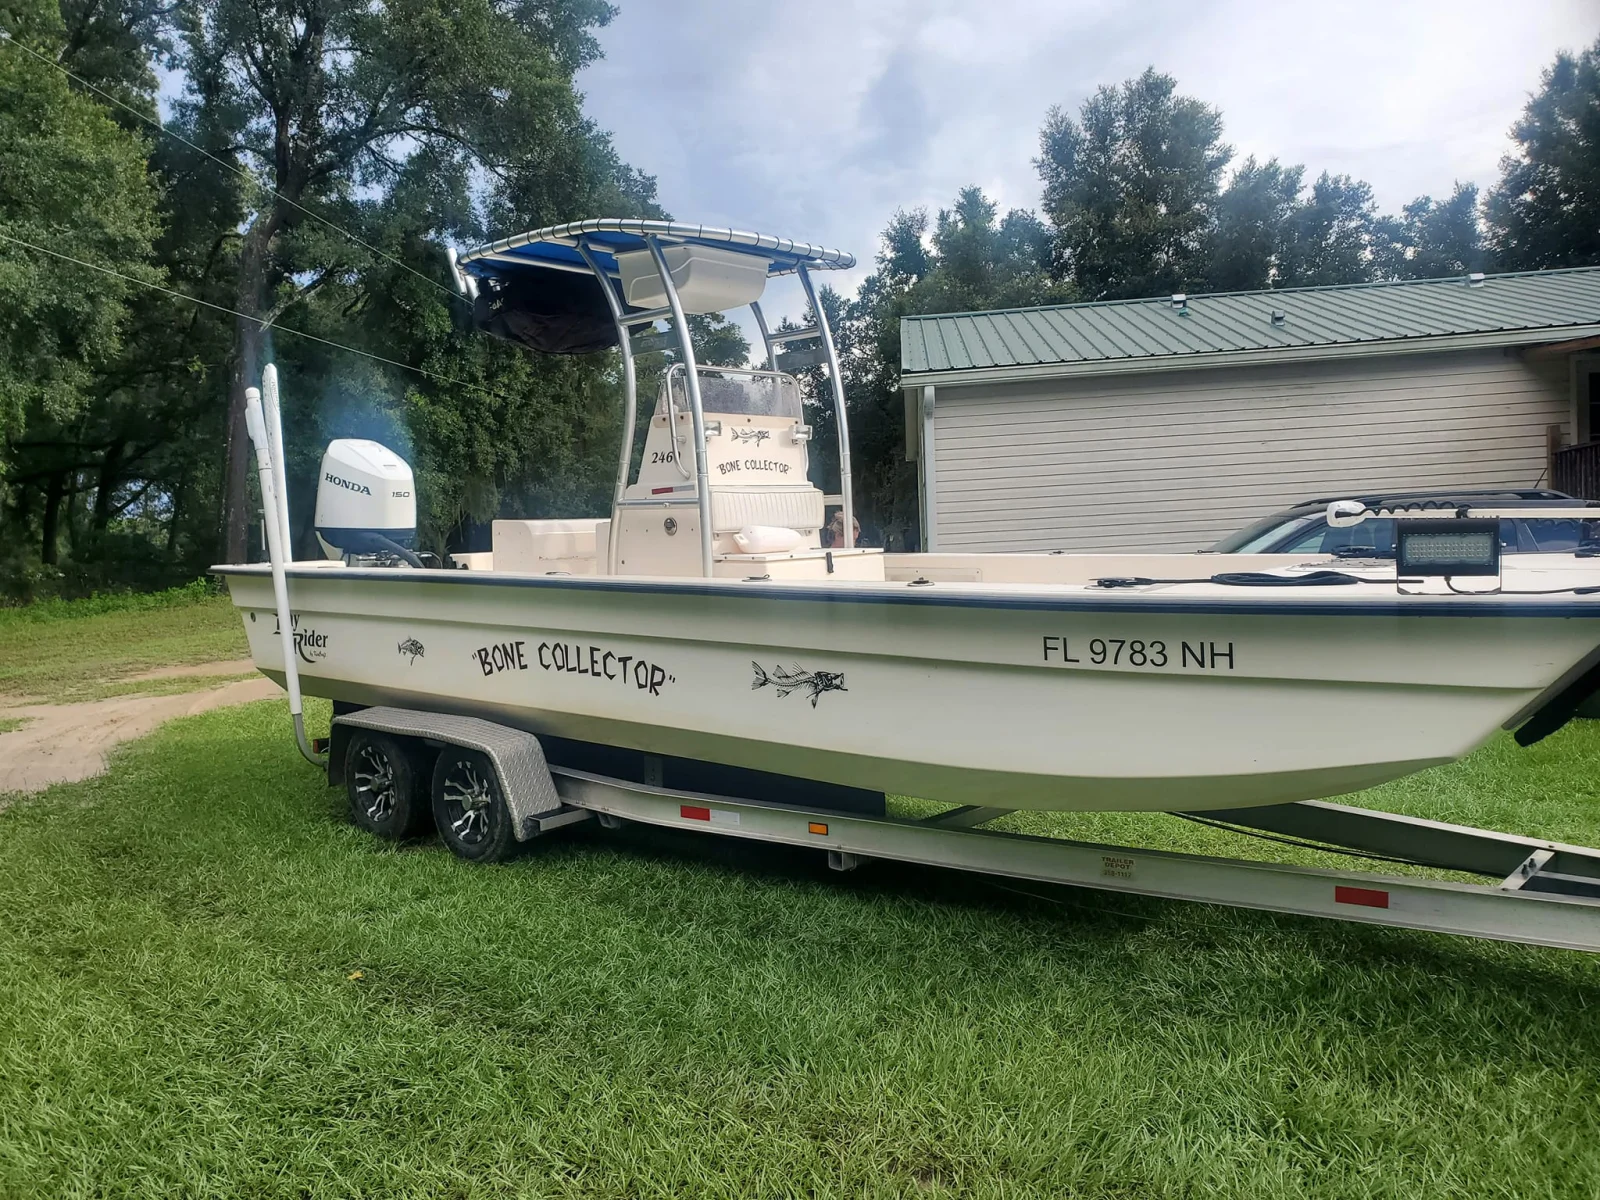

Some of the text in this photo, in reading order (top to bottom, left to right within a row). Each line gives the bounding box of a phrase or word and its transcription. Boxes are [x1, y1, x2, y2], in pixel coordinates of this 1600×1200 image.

[324, 472, 372, 496] HONDA
[292, 628, 328, 663] Rider
[1043, 636, 1234, 669] FL 9783 NH
[471, 641, 676, 697] "BONE COLLECTOR"
[1101, 856, 1134, 866] TRAILER
[1104, 862, 1130, 870] DEPOT
